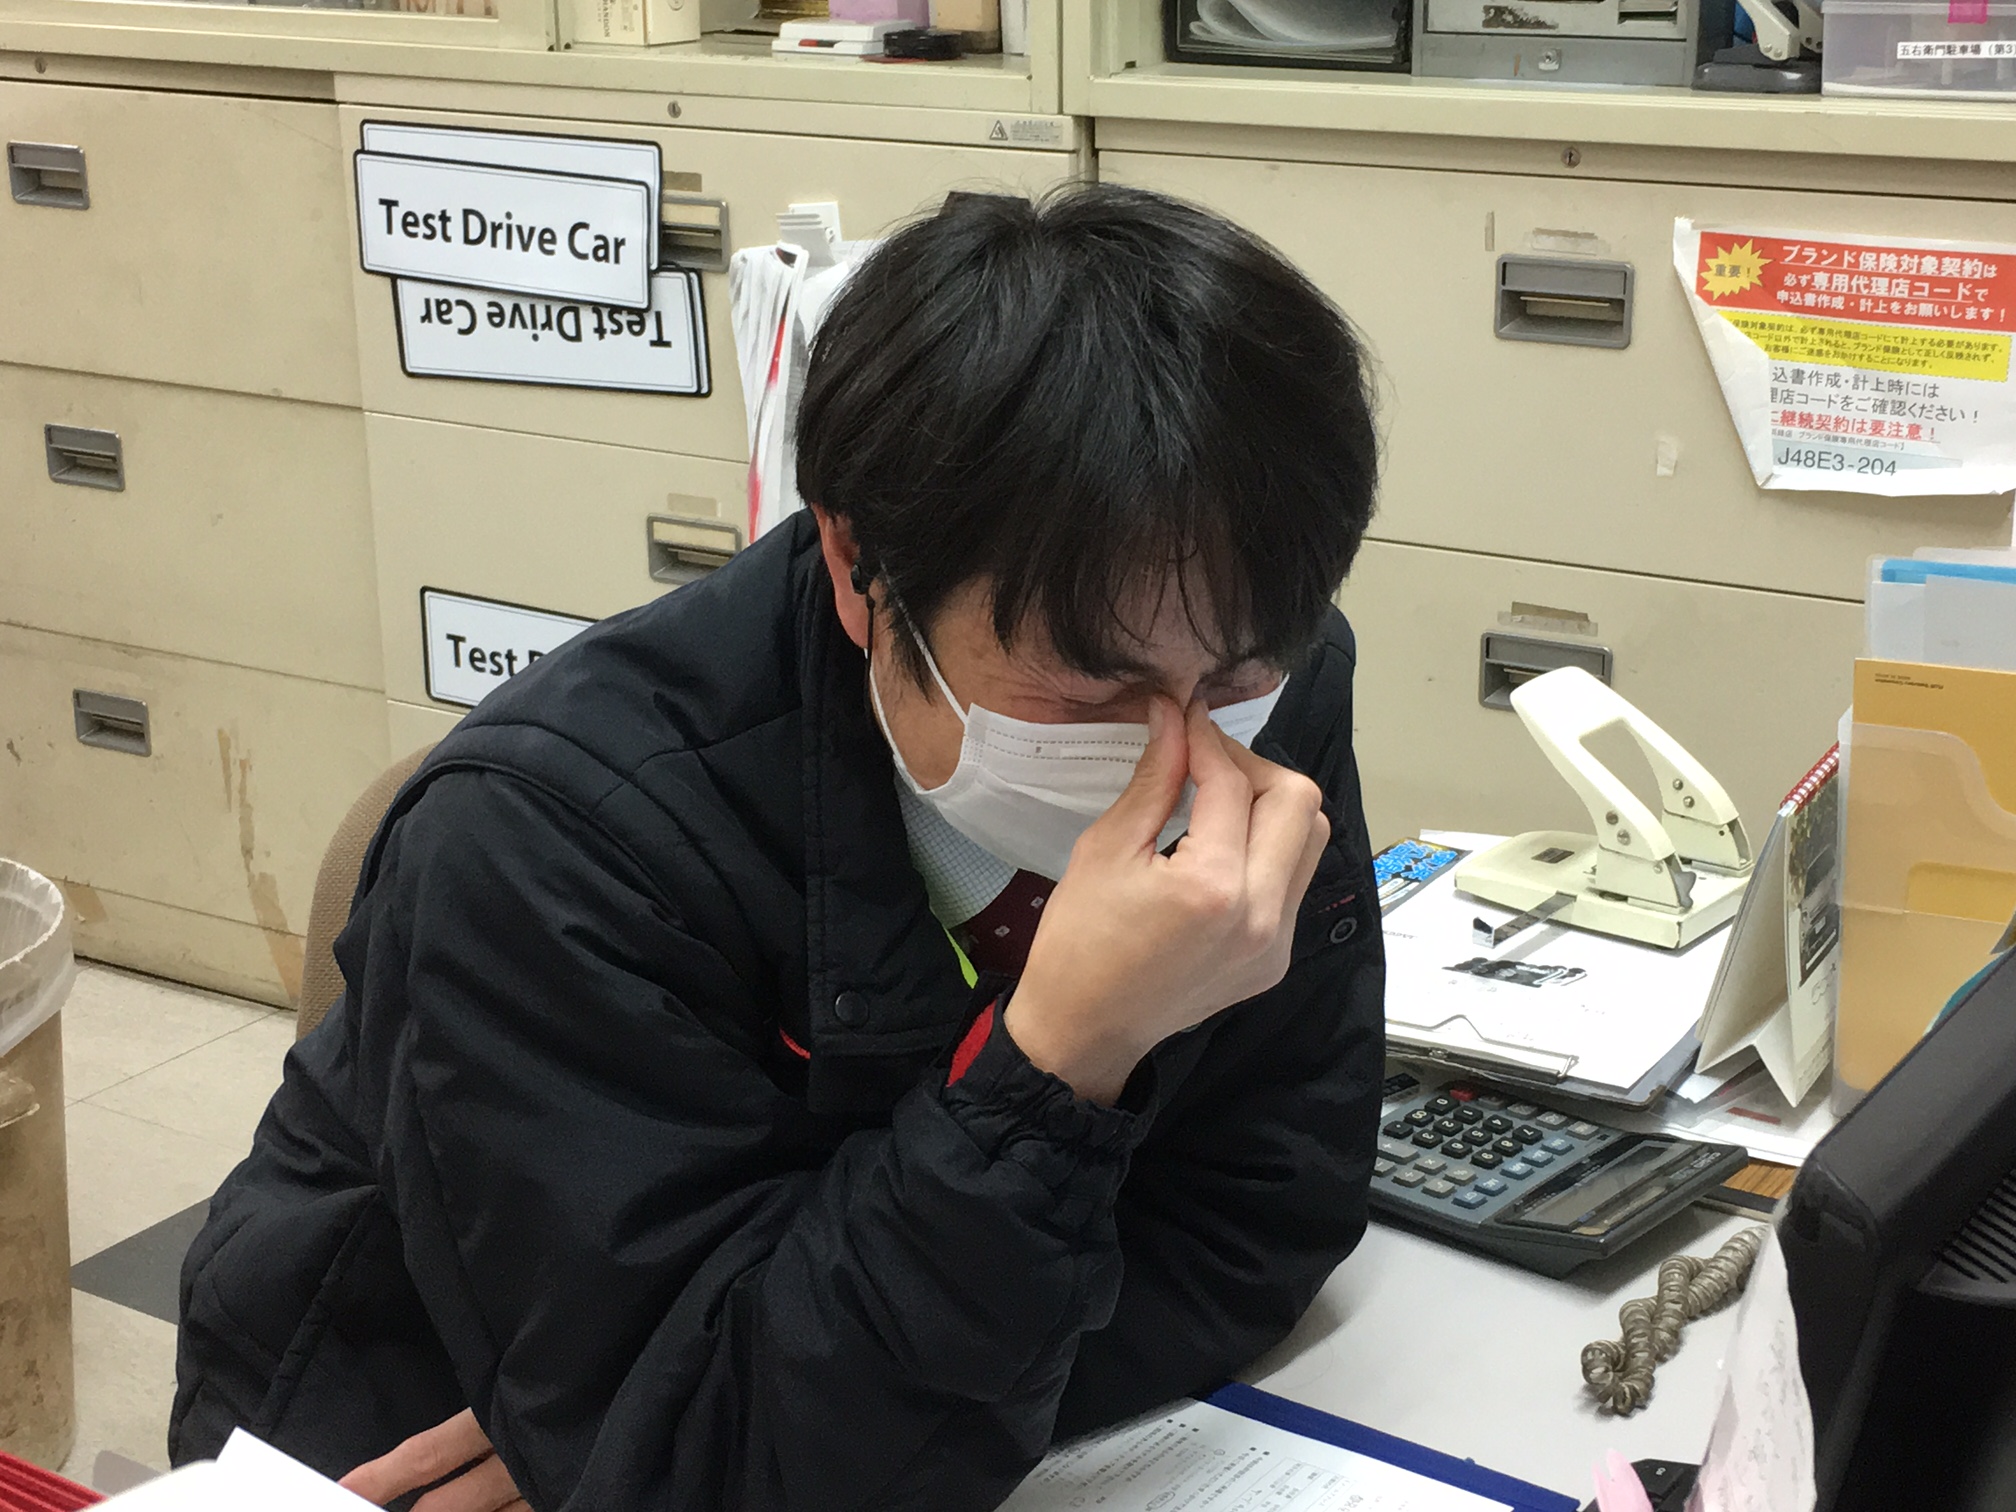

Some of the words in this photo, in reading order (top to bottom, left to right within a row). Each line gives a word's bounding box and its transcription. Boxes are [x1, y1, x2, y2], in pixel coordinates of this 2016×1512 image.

[378, 197, 452, 243] Test
[462, 208, 557, 256] Drive
[567, 221, 626, 265] Car
[1782, 245, 1998, 279] ブランド保険対象契約は
[1784, 272, 1989, 302] 必ず専用代理店コードで
[420, 297, 477, 336] Car
[487, 300, 582, 343] Drive
[592, 308, 672, 348] Test
[1778, 447, 1897, 476] J48E3-204
[446, 633, 518, 678] Test
